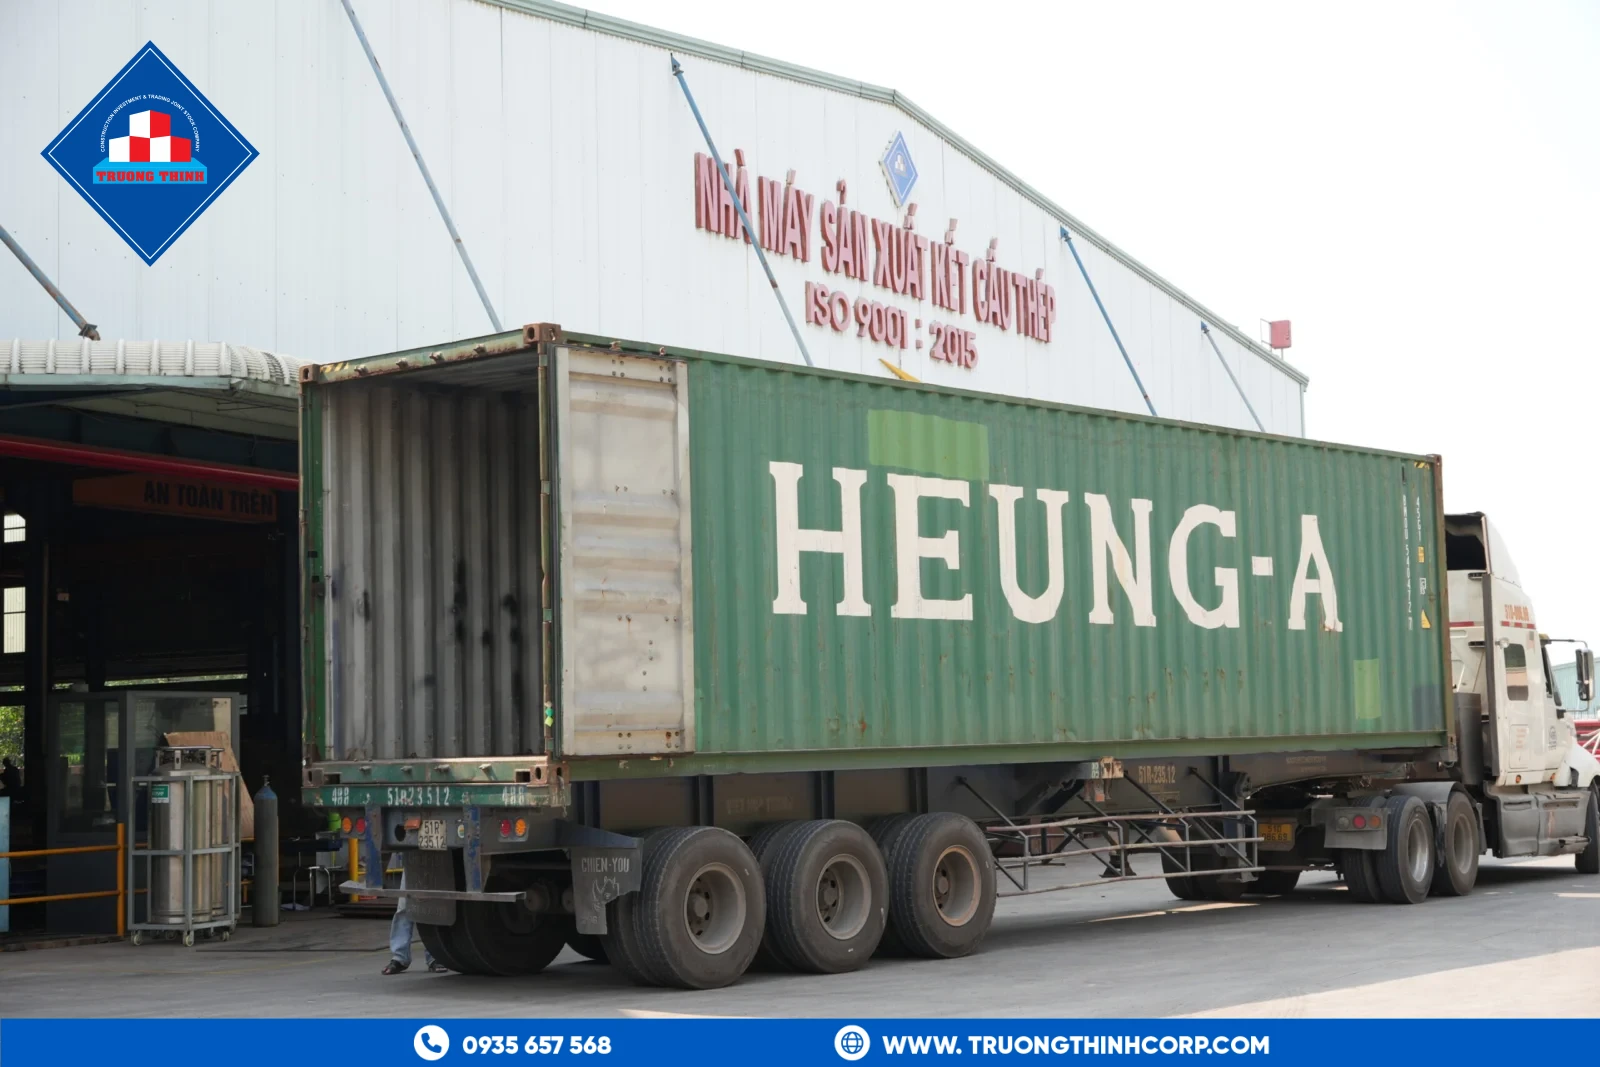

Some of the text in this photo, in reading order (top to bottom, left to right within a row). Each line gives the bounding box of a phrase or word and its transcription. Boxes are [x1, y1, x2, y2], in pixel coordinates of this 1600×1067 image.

[694, 148, 1056, 343] NHÀ MÁY SẢN XUẤT KẾT CẤU THÉP
[804, 280, 851, 332] ISO
[854, 297, 908, 349] 9001
[929, 320, 979, 369] 2015
[144, 480, 273, 515] AN TOÀN TRÊN
[769, 461, 1343, 632] HEUNG-A
[1138, 765, 1176, 784] 51R-235.12
[331, 787, 350, 806] 488
[424, 821, 440, 834] 51R
[419, 835, 447, 849] 235.12
